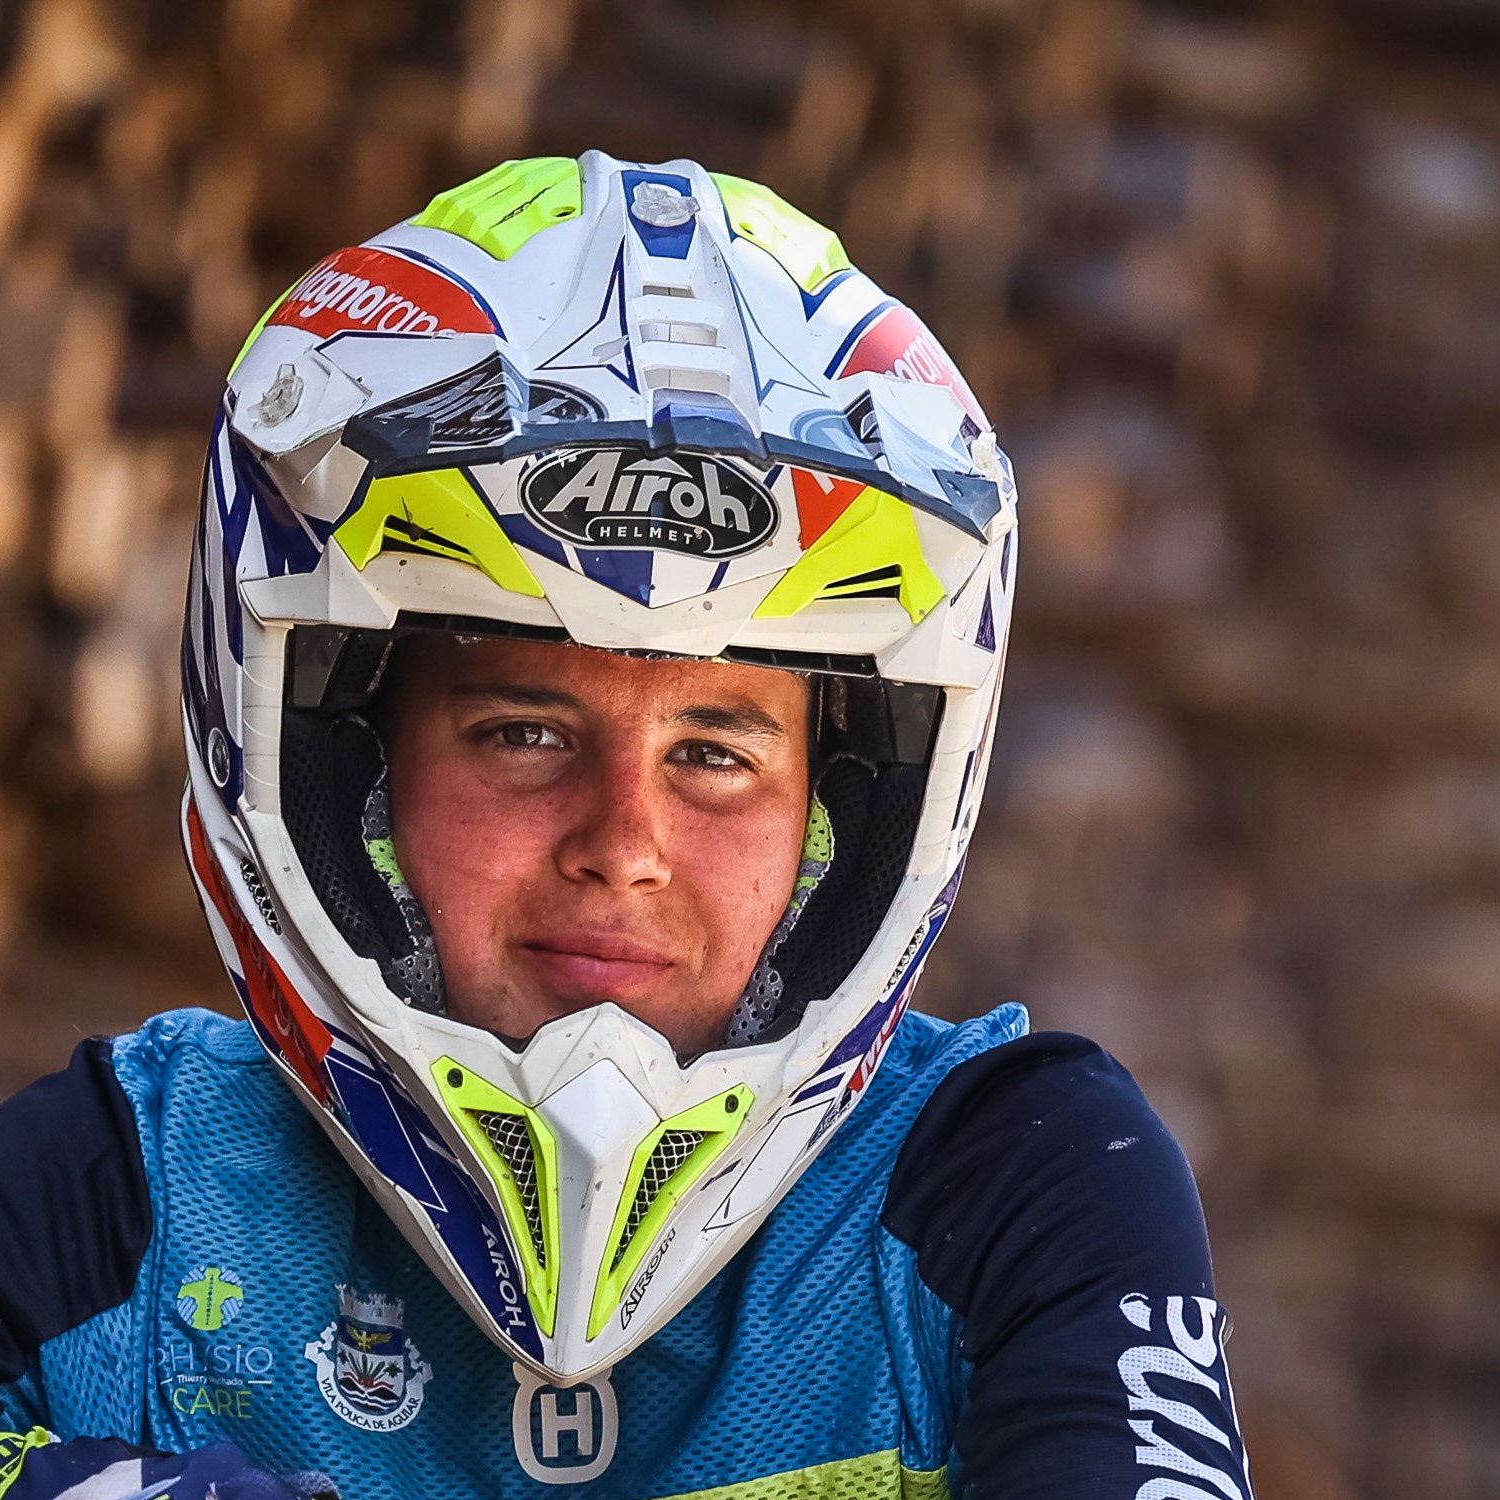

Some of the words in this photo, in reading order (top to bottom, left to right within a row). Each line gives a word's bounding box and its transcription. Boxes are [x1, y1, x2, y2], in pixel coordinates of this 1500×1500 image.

[541, 451, 752, 534] Airoh
[598, 524, 695, 546] HELMET
[480, 1222, 528, 1328] AIROH
[619, 1226, 678, 1331] AIROH
[173, 1387, 253, 1419] CARE
[321, 1376, 336, 1403] VILA
[335, 1401, 371, 1429] POUCA
[372, 1420, 387, 1430] DE
[387, 1397, 421, 1429] AGUIAR
